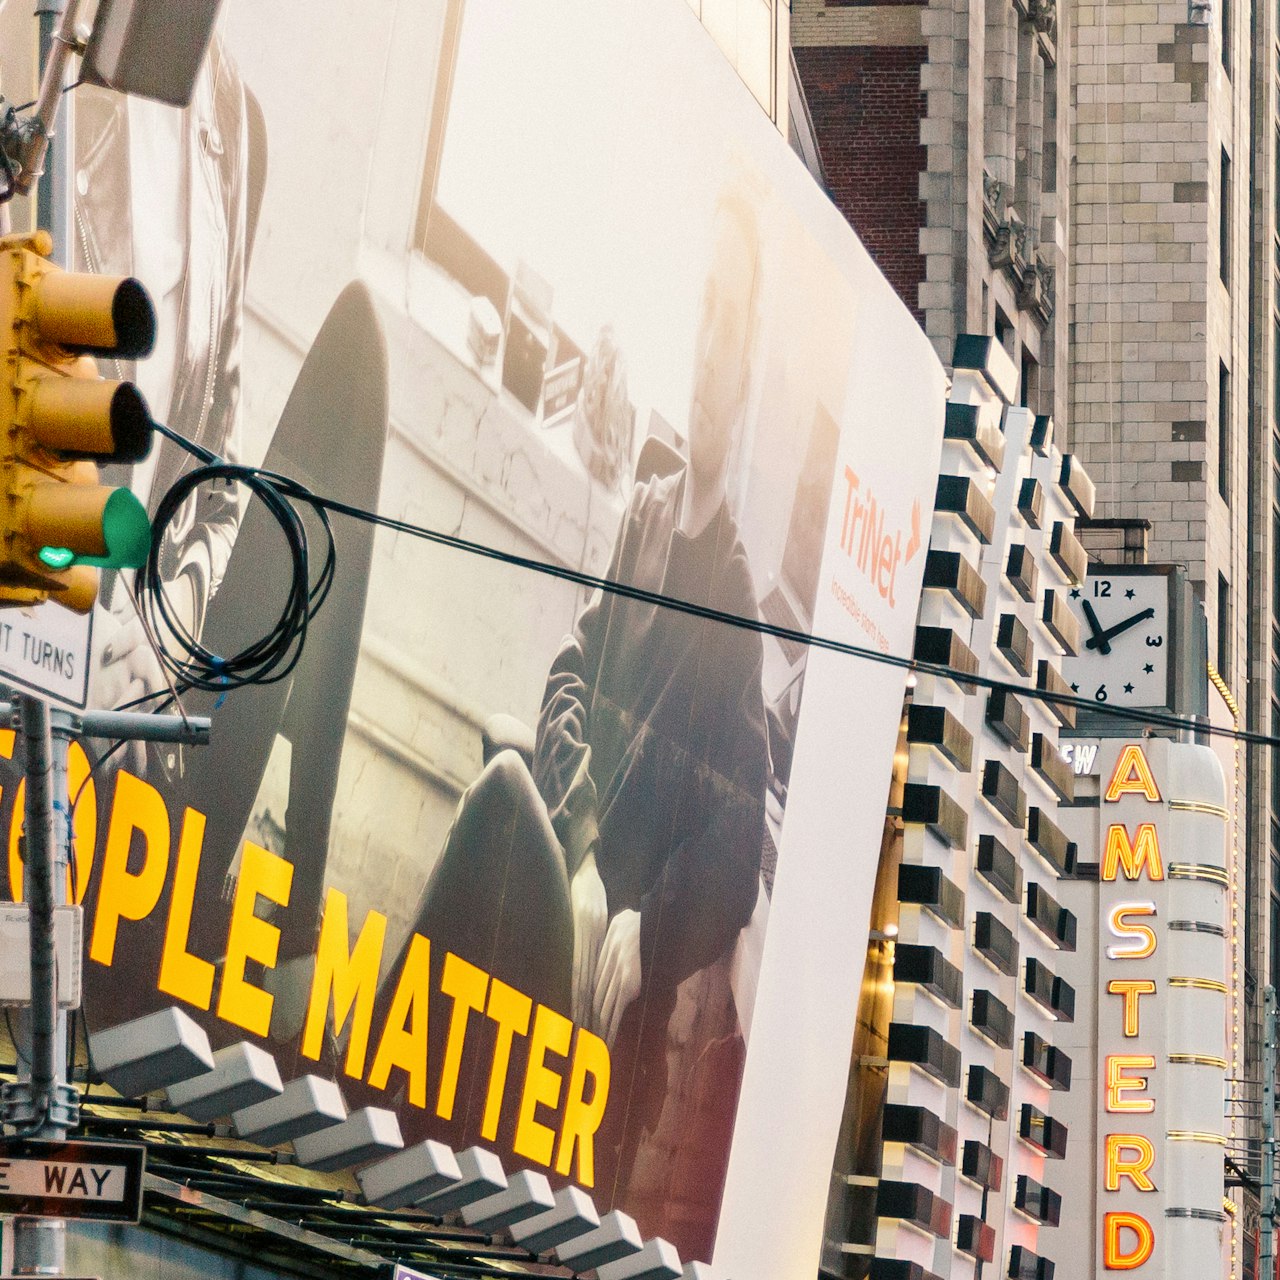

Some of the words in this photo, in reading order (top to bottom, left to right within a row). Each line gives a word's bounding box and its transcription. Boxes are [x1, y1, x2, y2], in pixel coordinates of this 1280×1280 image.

[840, 464, 901, 609] TriNet
[1093, 580, 1112, 598] 12
[23, 632, 74, 679] TURNS
[1145, 635, 1163, 648] 3
[1094, 684, 1108, 702] 6
[302, 887, 611, 1188] MATTER
[44, 1166, 111, 1196] WAY
